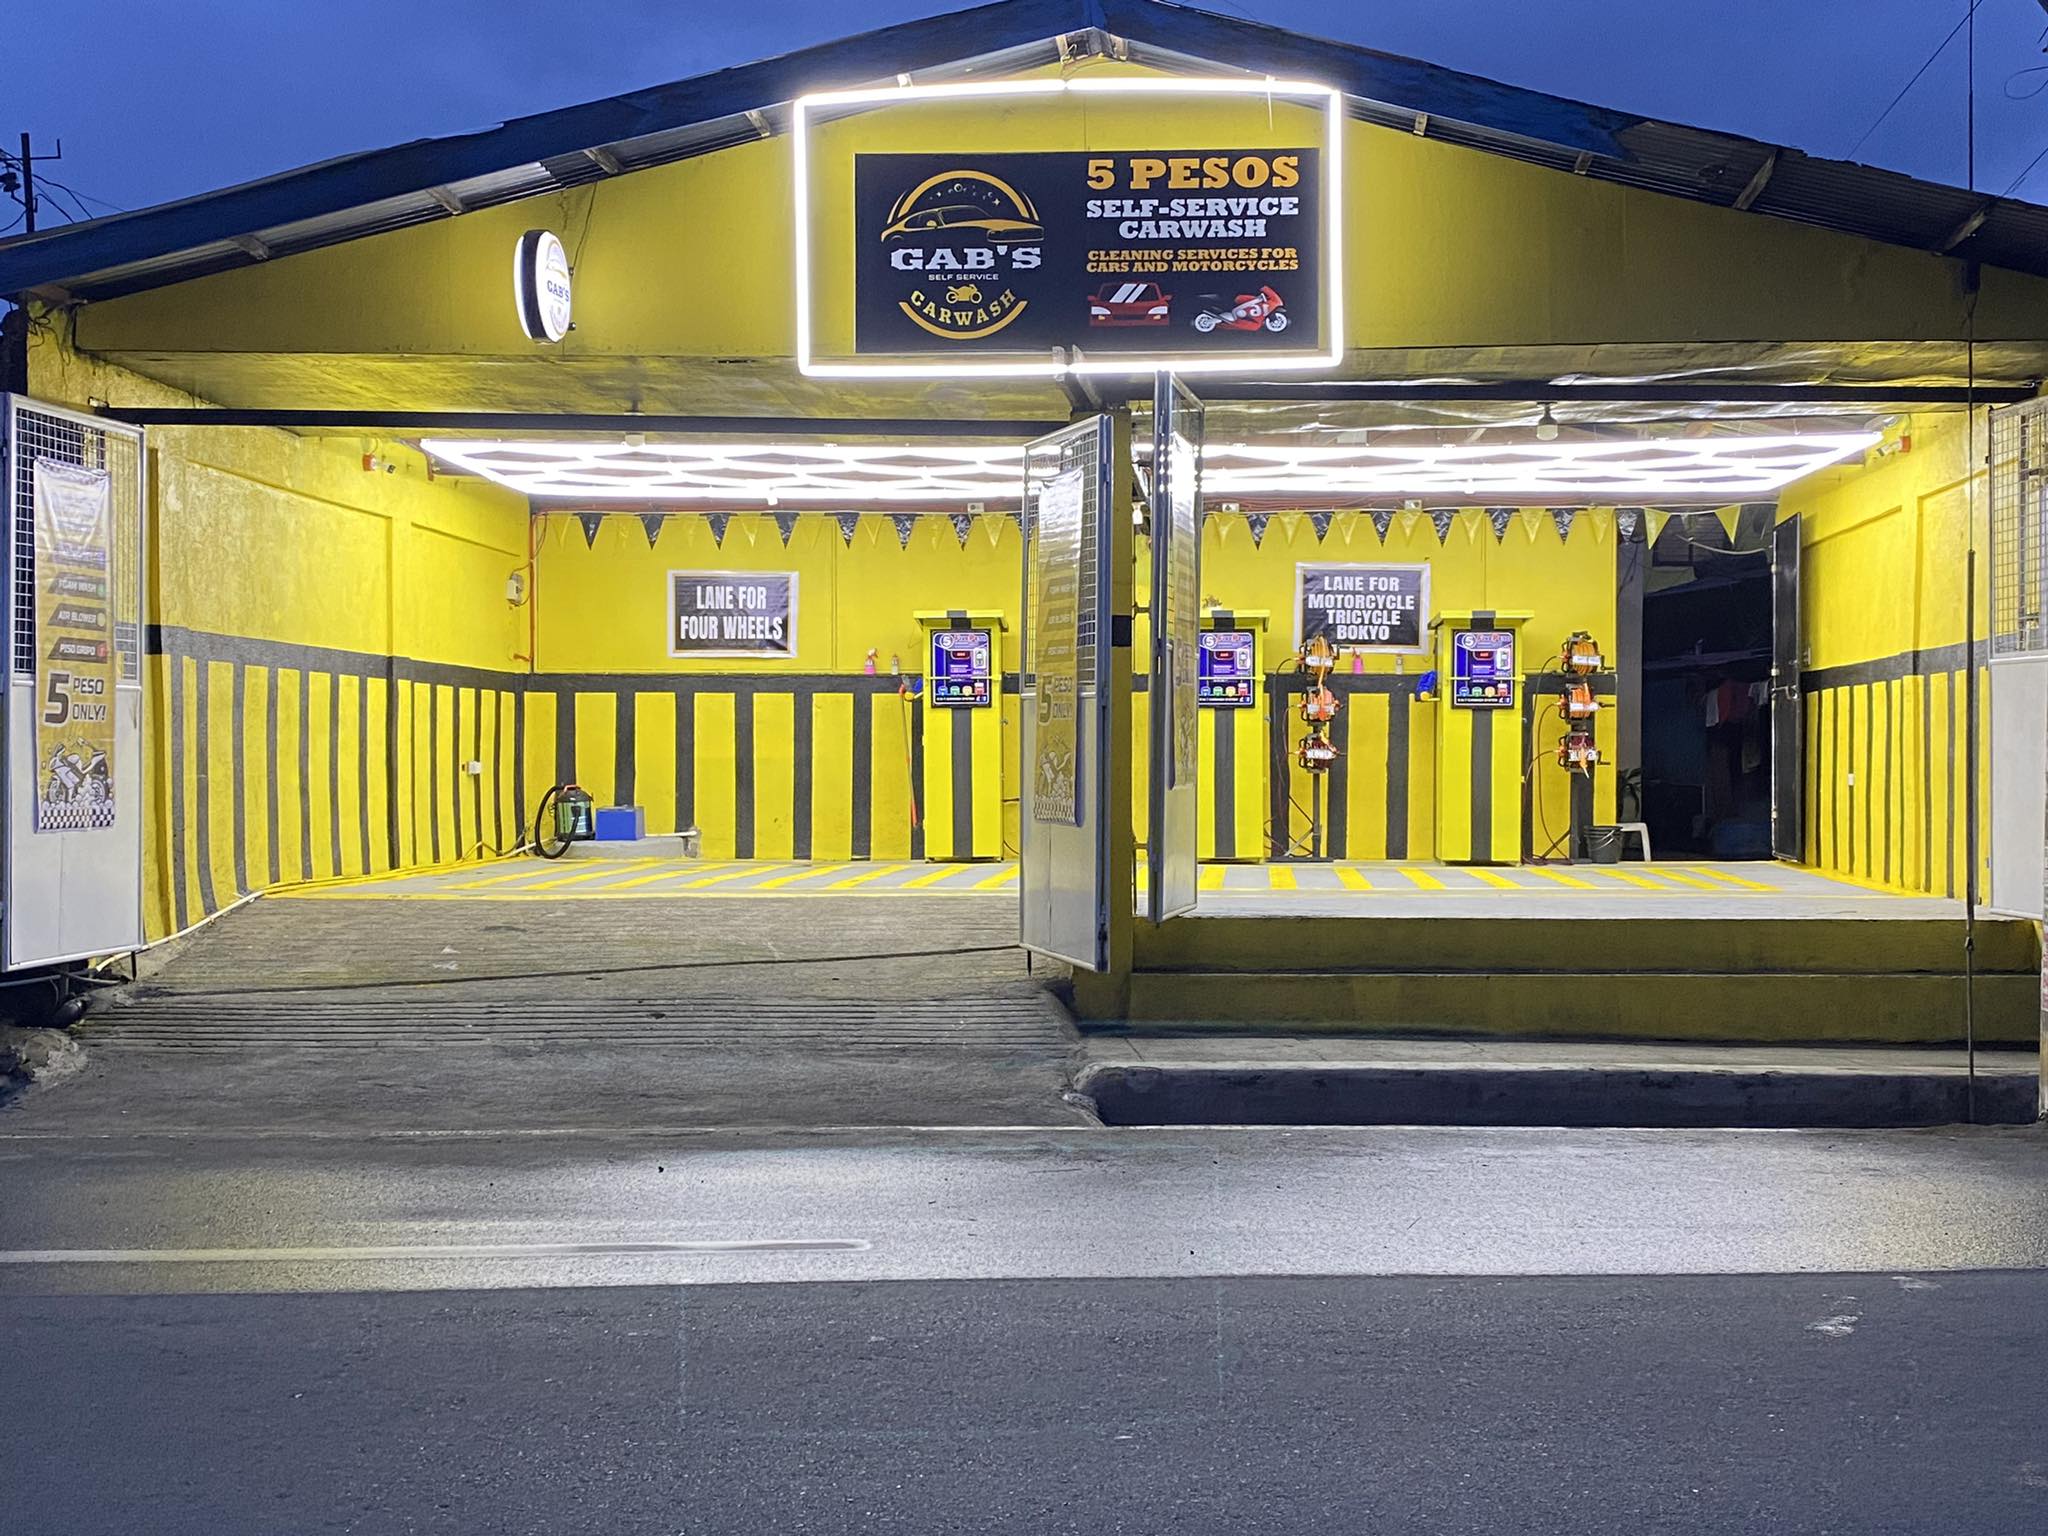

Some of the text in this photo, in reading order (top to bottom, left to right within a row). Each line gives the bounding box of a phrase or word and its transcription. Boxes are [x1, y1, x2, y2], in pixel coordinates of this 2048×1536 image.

[1086, 156, 1300, 190] 5 PESOS
[1086, 196, 1299, 218] SELF-SERVICE
[1119, 218, 1267, 239] CARWASH
[890, 245, 1042, 271] GAB'S
[1087, 247, 1297, 261] CLEANING SERVICES FOR
[1086, 259, 1299, 273] CARS AND MOTORCYCLES
[928, 273, 999, 281] SELF SERVICE
[910, 288, 1017, 326] CARWASH
[1323, 576, 1400, 592] LANE FOR
[696, 585, 767, 609] LANE FOR
[1307, 593, 1415, 610] MOTORCYCLE
[1326, 609, 1401, 625] TRICYCLE
[680, 615, 783, 640] FOUR WHEELS
[1336, 625, 1390, 640] BOKYO
[44, 672, 104, 724] 5 PESO
[72, 703, 106, 720] ONLY!
